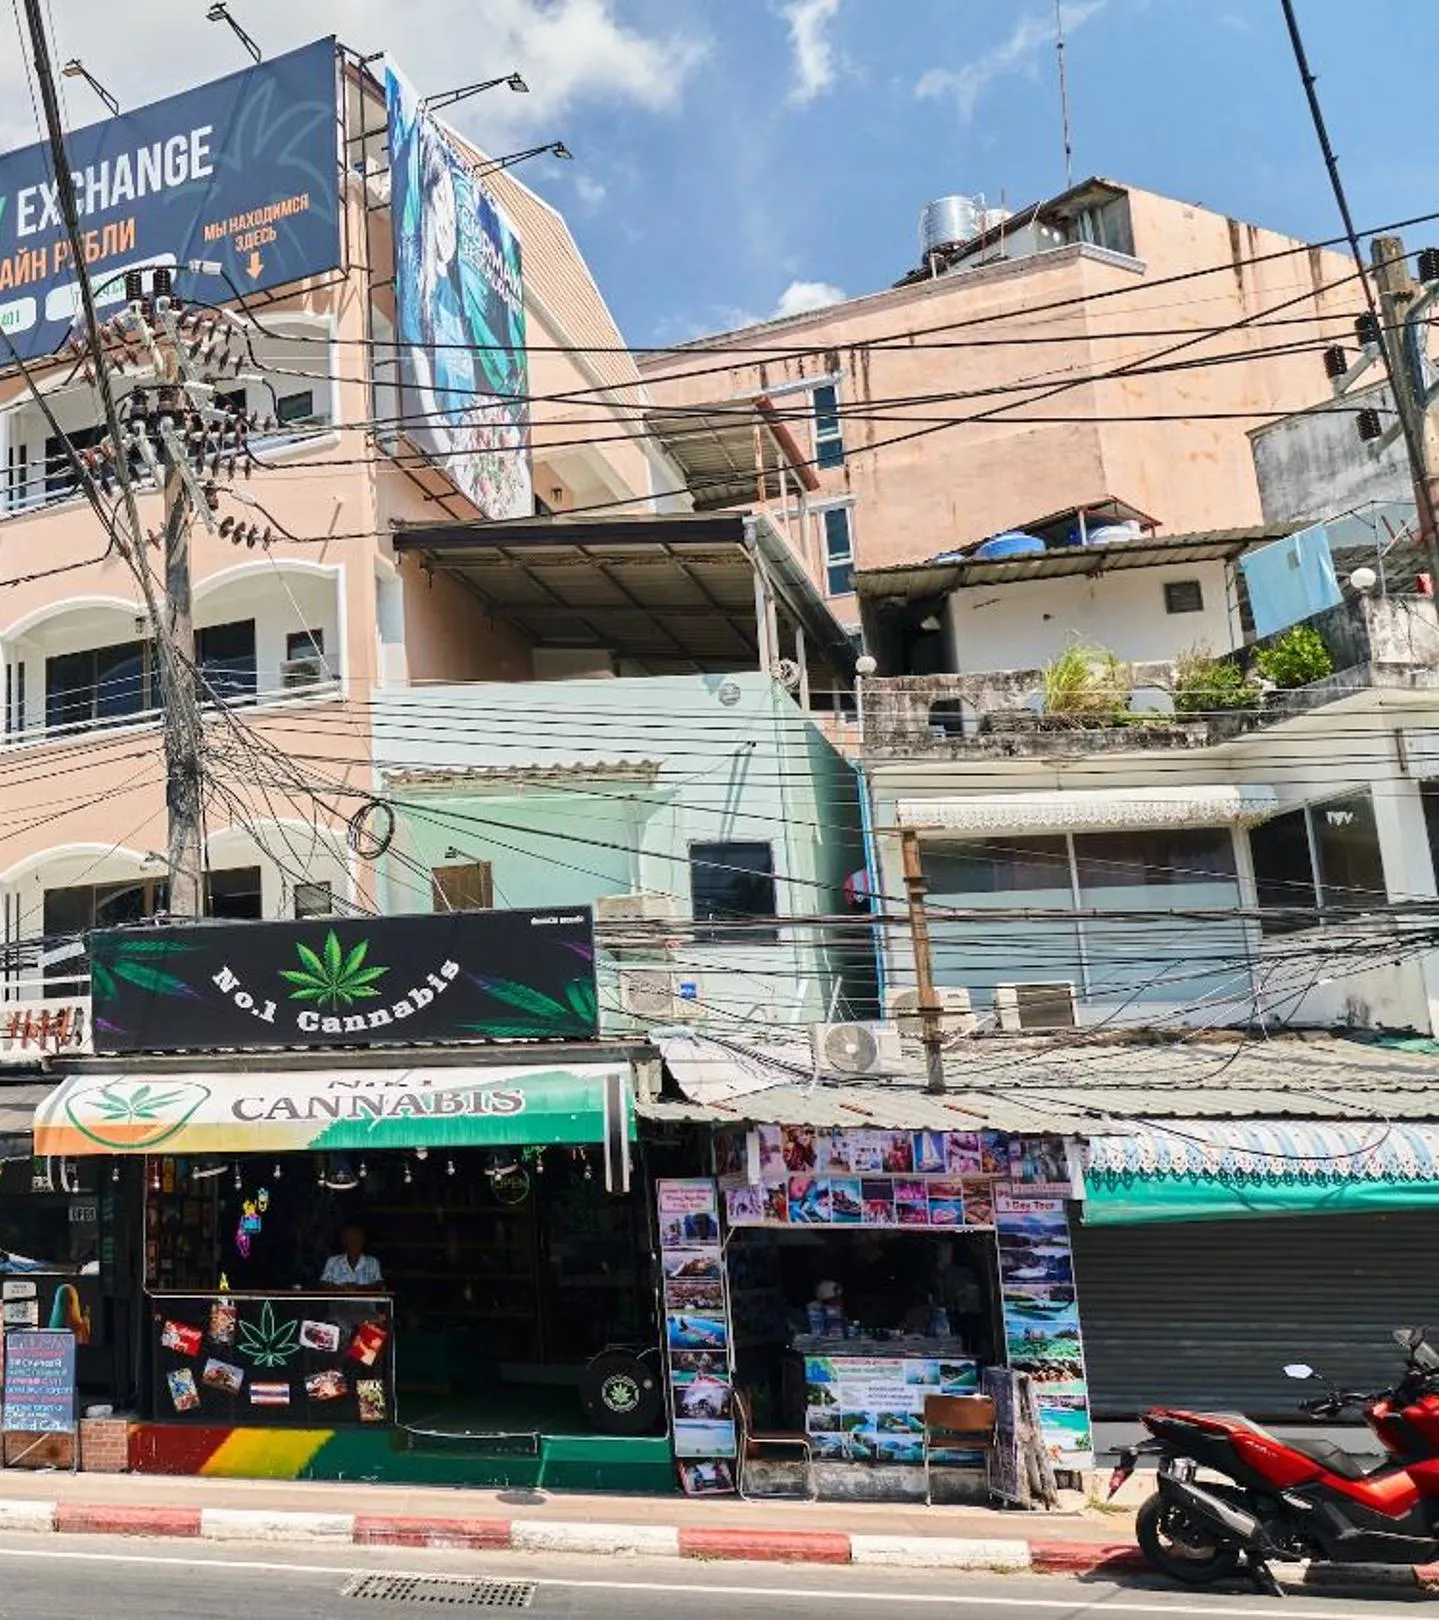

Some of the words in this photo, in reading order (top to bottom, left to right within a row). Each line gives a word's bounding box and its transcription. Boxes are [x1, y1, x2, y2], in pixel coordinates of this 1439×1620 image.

[17, 126, 214, 237] EXCHANGE
[204, 220, 226, 242] МЫ
[229, 192, 309, 233] НАХОДИМСЯ
[235, 227, 277, 252] ЗДЕСЬ
[212, 965, 277, 1023] No.1
[297, 959, 459, 1033] Cannabis
[231, 1089, 523, 1121] CANNABIS
